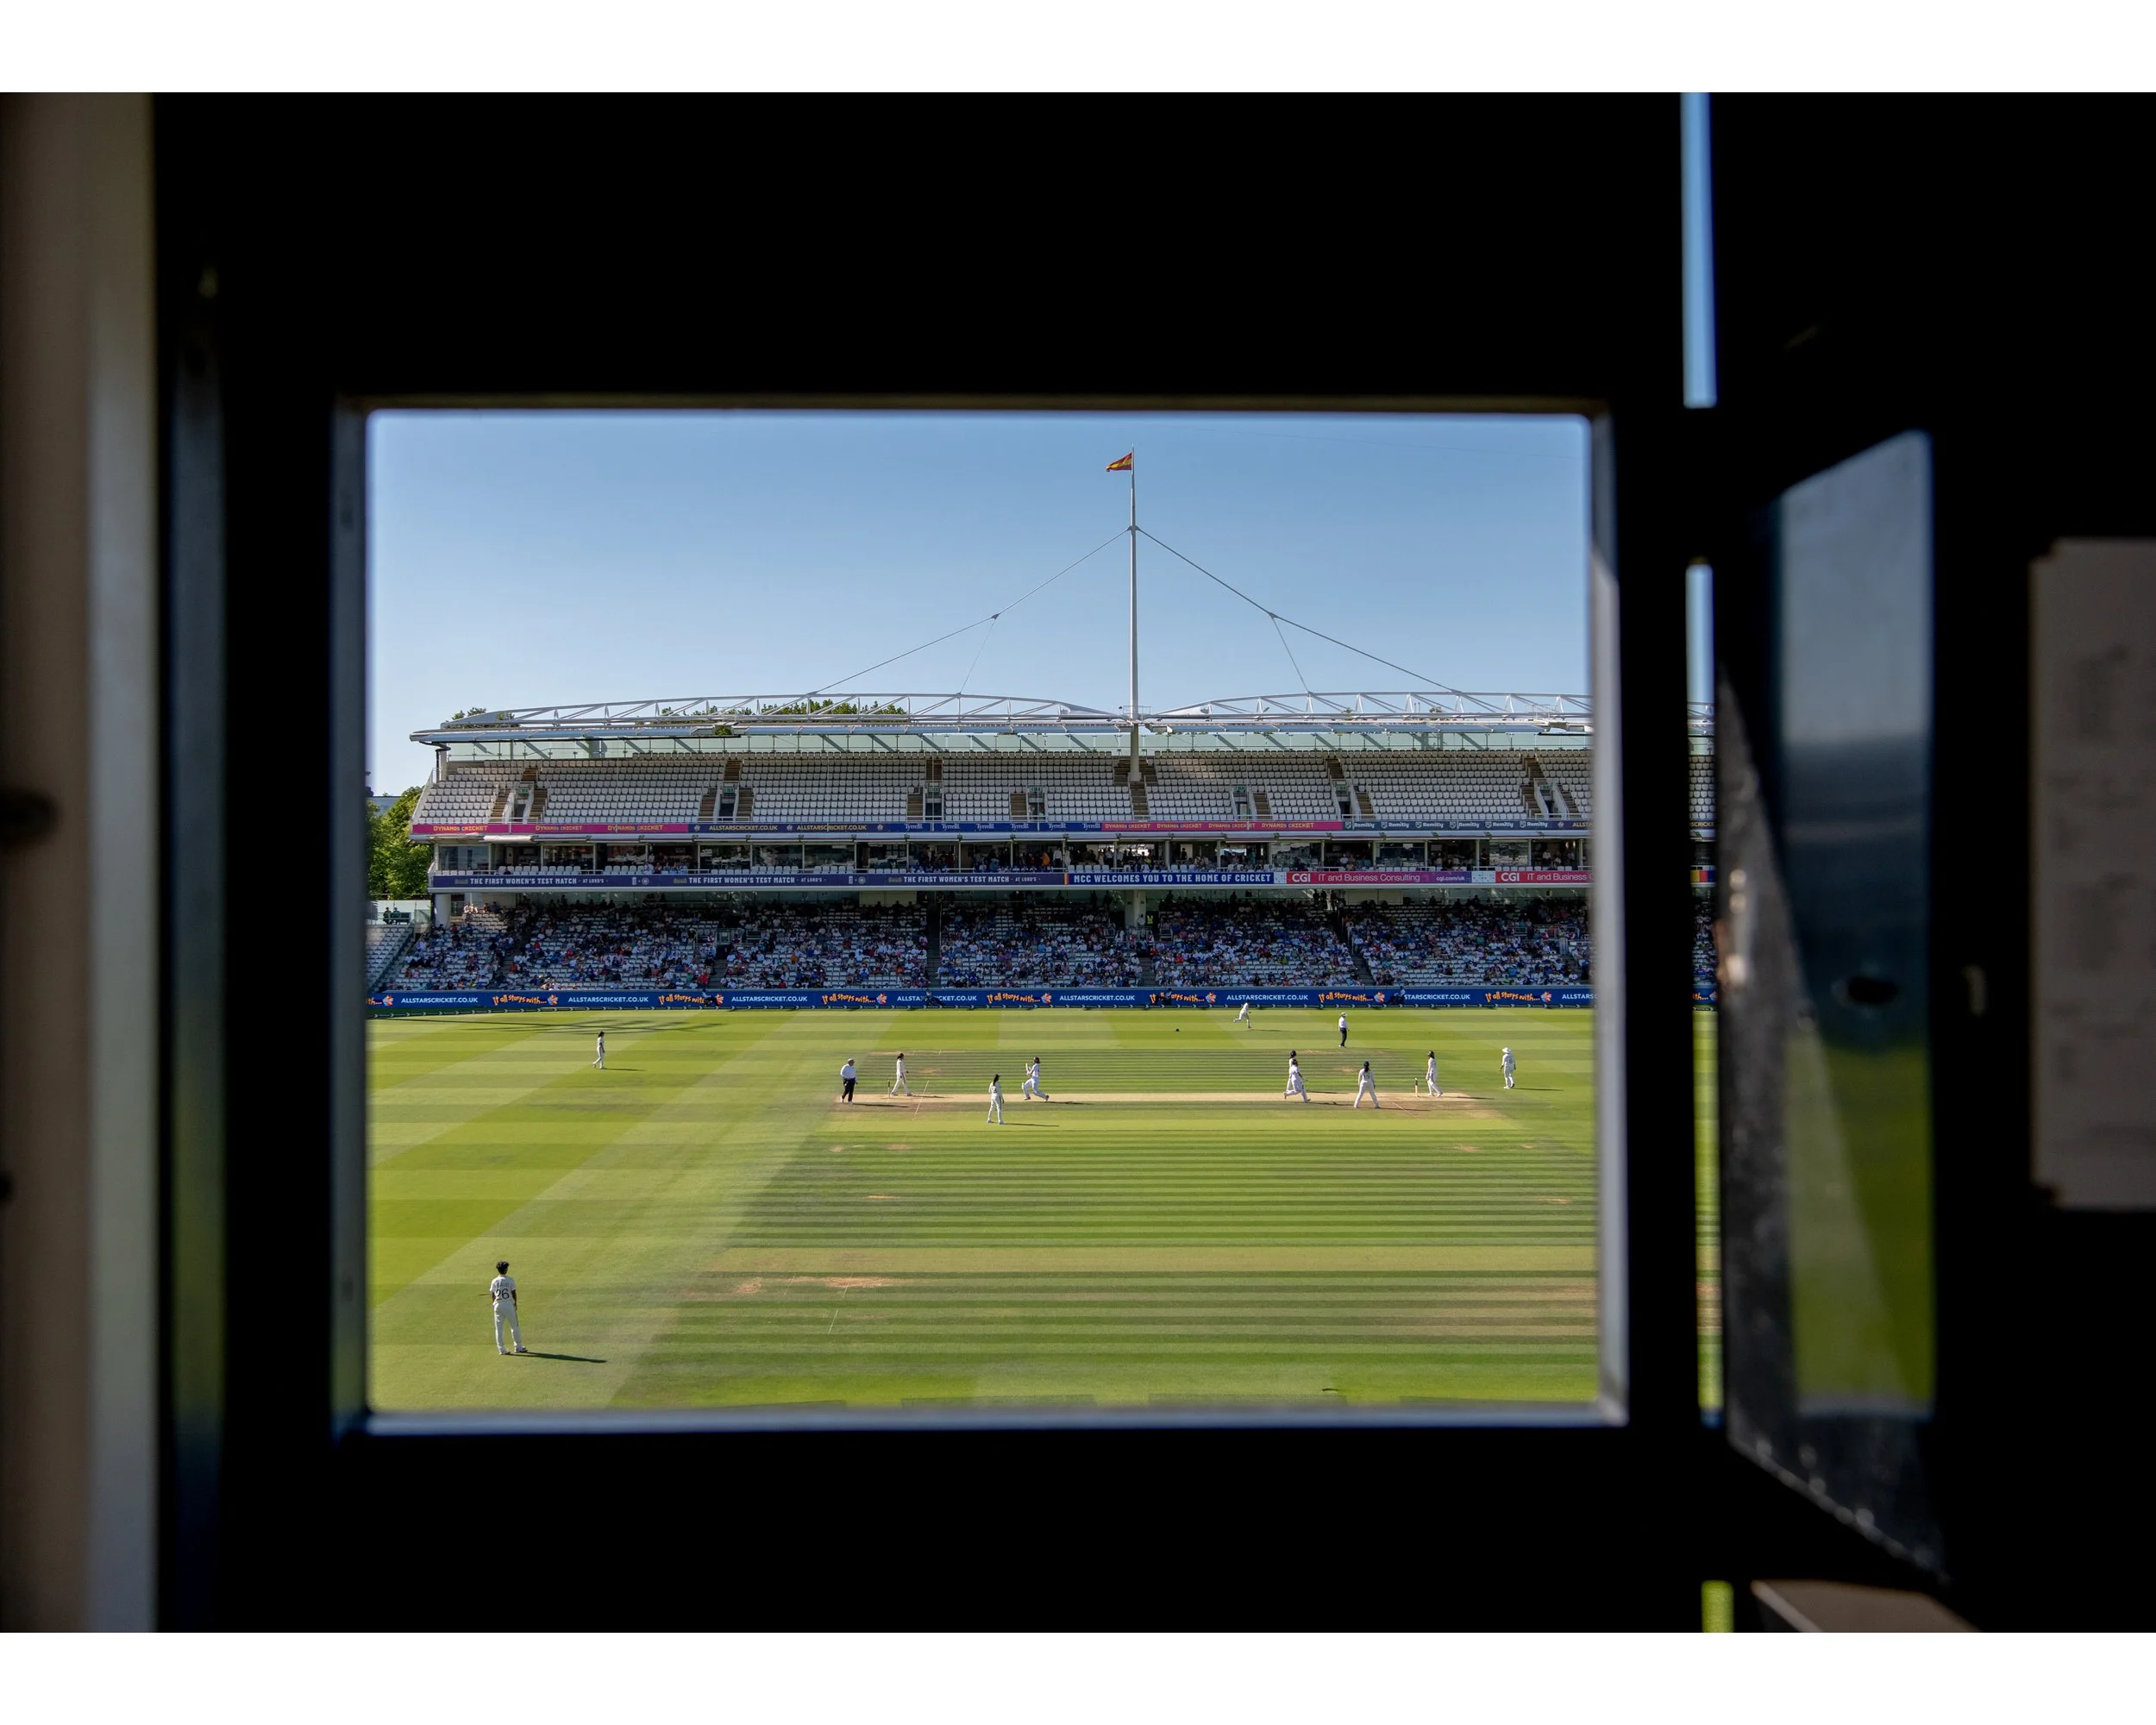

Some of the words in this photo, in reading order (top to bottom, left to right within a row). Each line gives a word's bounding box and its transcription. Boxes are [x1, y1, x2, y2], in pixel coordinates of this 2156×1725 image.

[1074, 875, 1091, 883] MCC
[1094, 875, 1140, 883] WELCOMES
[1143, 875, 1159, 883] YOU
[1163, 875, 1173, 883] TO
[1177, 875, 1193, 883] THE
[1195, 875, 1219, 883] HOME
[1221, 875, 1232, 883] OF
[1235, 875, 1271, 883] CRICKET
[1291, 874, 1311, 882] CGI
[1380, 874, 1420, 883] Consulting
[1501, 873, 1520, 881] CGI
[496, 1288, 509, 1300] 26
